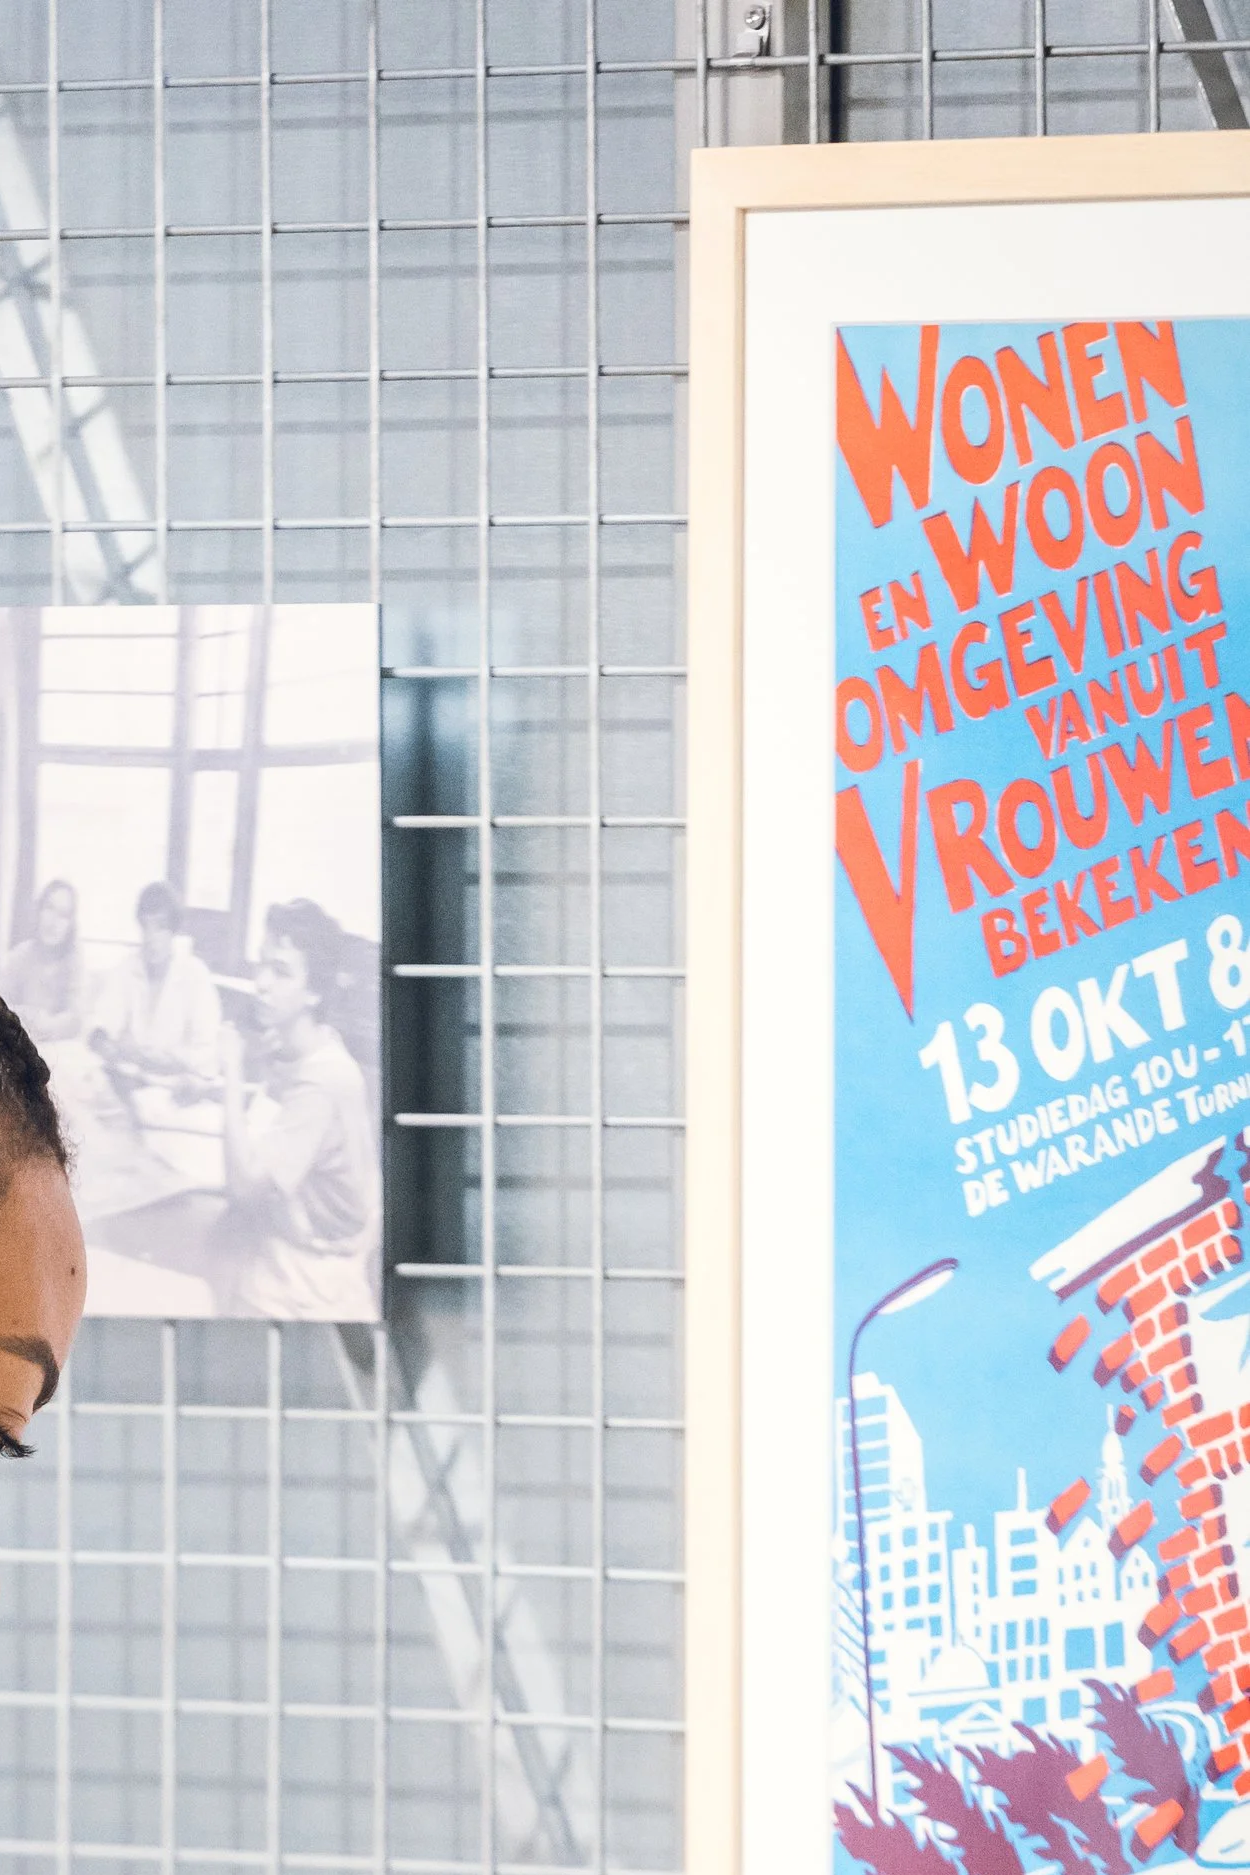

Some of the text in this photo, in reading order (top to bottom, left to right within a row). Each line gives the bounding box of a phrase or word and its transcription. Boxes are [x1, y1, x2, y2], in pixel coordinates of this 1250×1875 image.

[836, 321, 1188, 528] WONEN
[860, 415, 1206, 653] EN WOON
[836, 531, 1224, 773] OMGEVING
[1024, 622, 1227, 759] VANUIT
[980, 799, 1250, 979] BEKEKEN
[918, 1002, 1020, 1124] 13
[1030, 938, 1188, 1081] OKT
[954, 1074, 1130, 1176] STUDIEDAG
[1131, 1044, 1198, 1096] 10U
[961, 1073, 1250, 1218] DE WARANDE TURN
